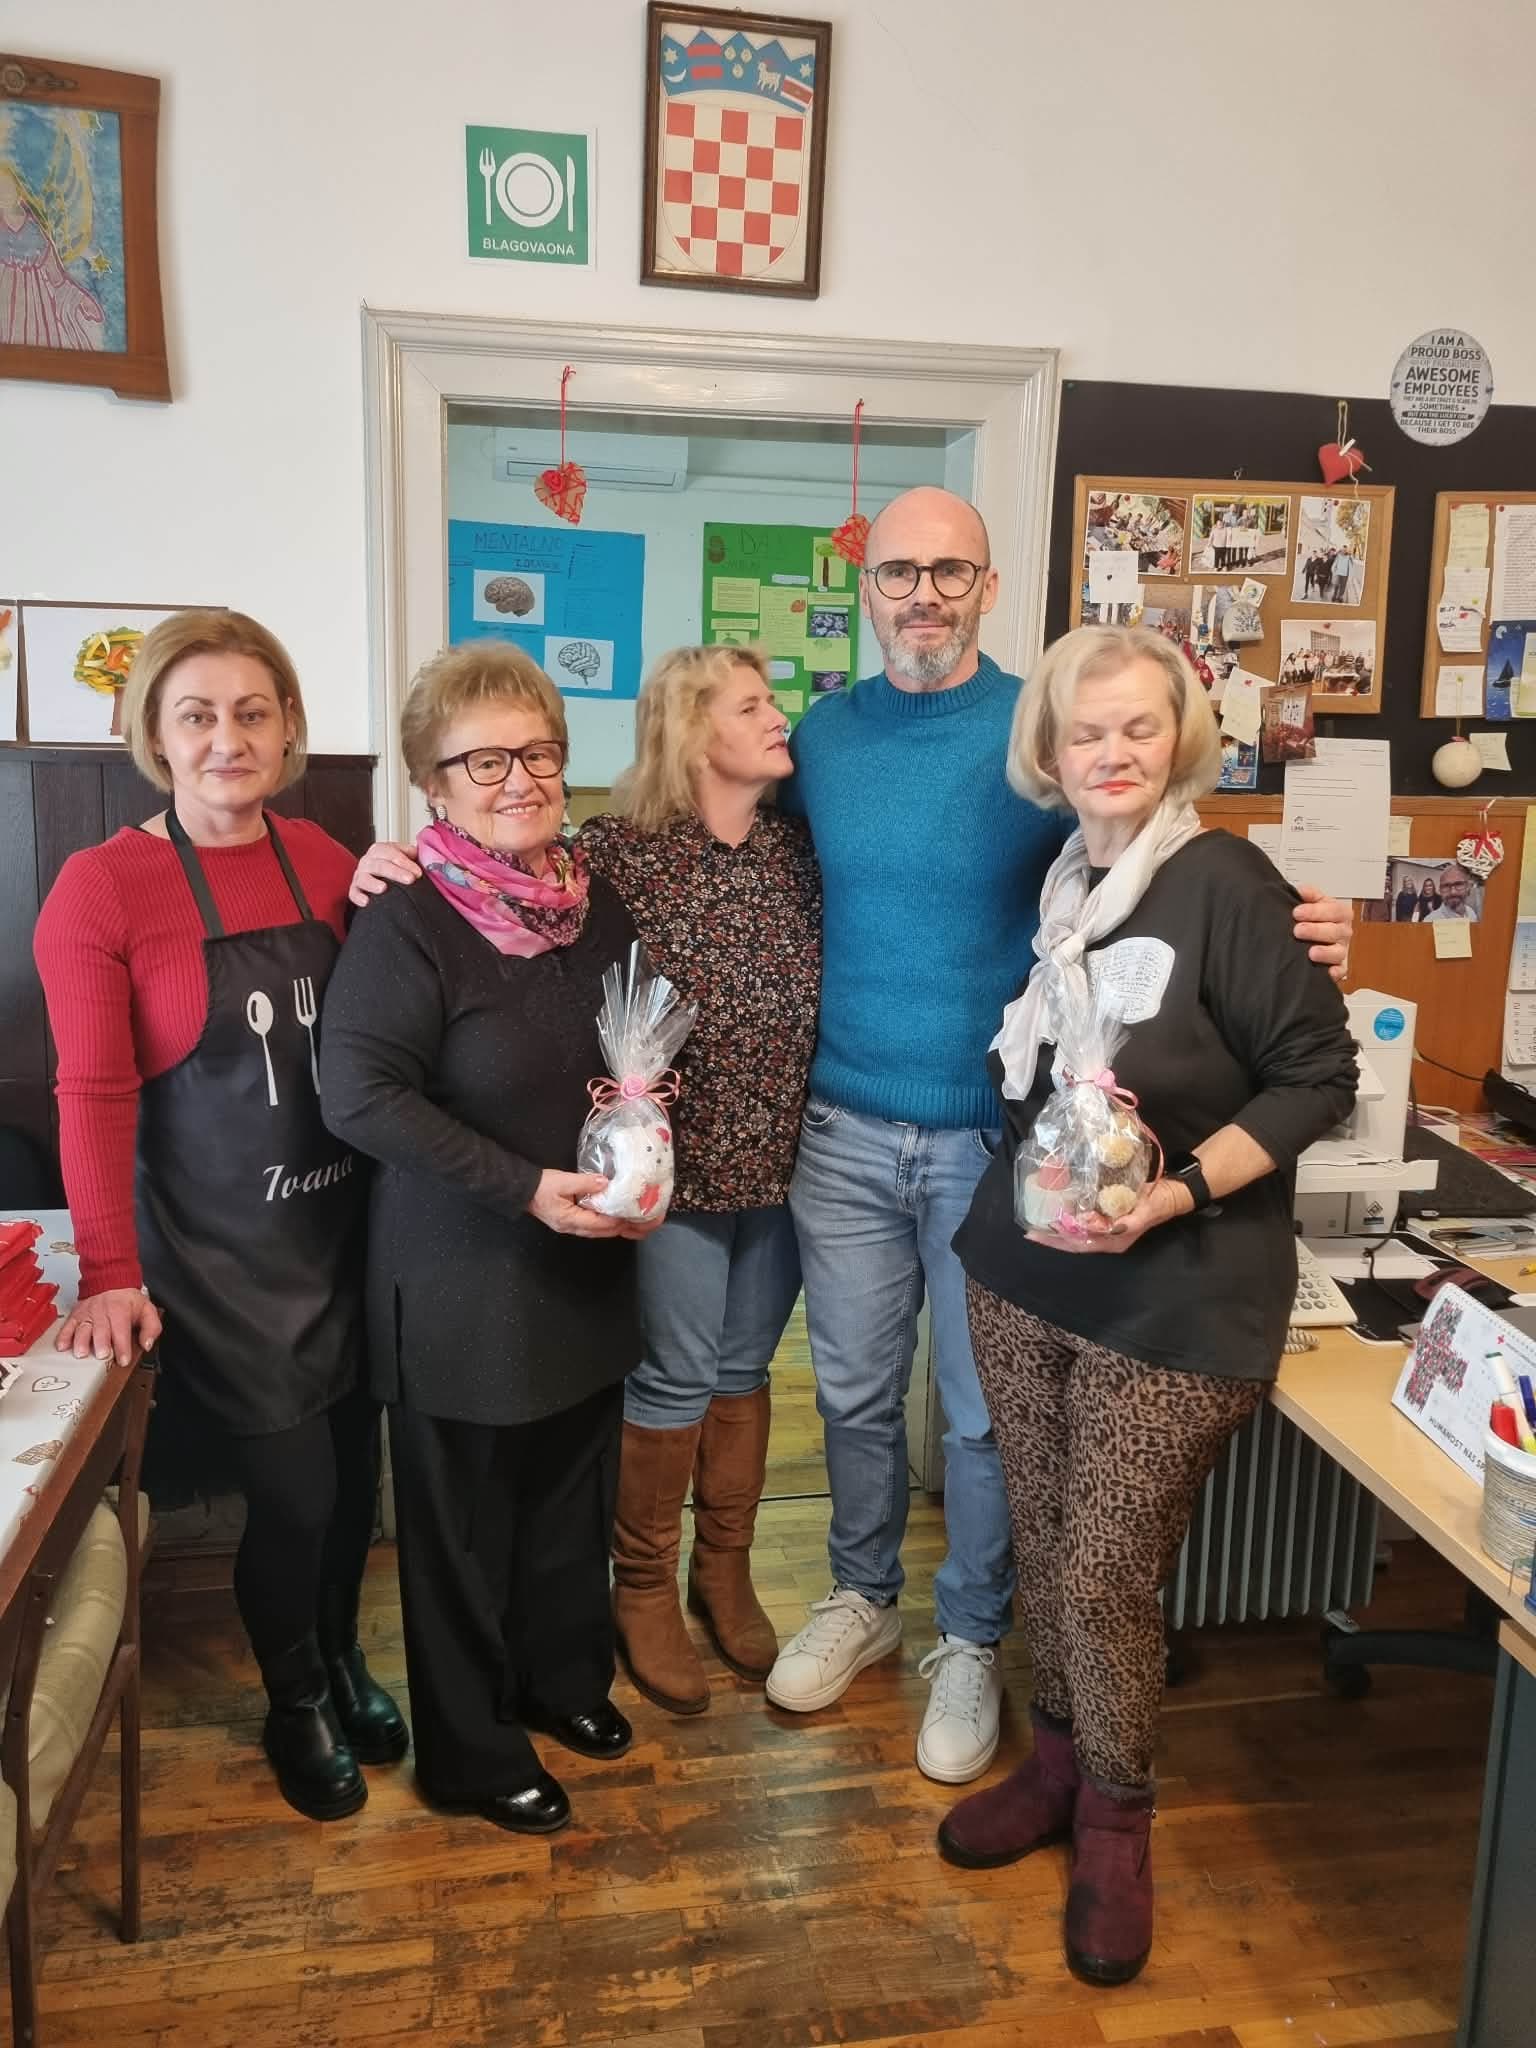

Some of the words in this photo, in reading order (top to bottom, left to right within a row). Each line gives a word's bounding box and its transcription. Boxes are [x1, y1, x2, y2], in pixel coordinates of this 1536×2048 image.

[482, 237, 575, 256] BLAGOVAONA
[1431, 335, 1435, 345] I
[1437, 335, 1455, 346] AM
[1457, 336, 1464, 346] A
[1410, 346, 1450, 358] PROUD
[1452, 349, 1481, 360] BOSS
[1406, 366, 1481, 384] AWESOME
[1404, 382, 1479, 398] EMPLOYEES
[1419, 402, 1459, 411] SOMETIMES
[1400, 418, 1432, 427] BECAUSE
[1439, 427, 1457, 435] BOSS
[262, 1154, 353, 1201] Ivana
[1463, 1447, 1477, 1463] NAS
